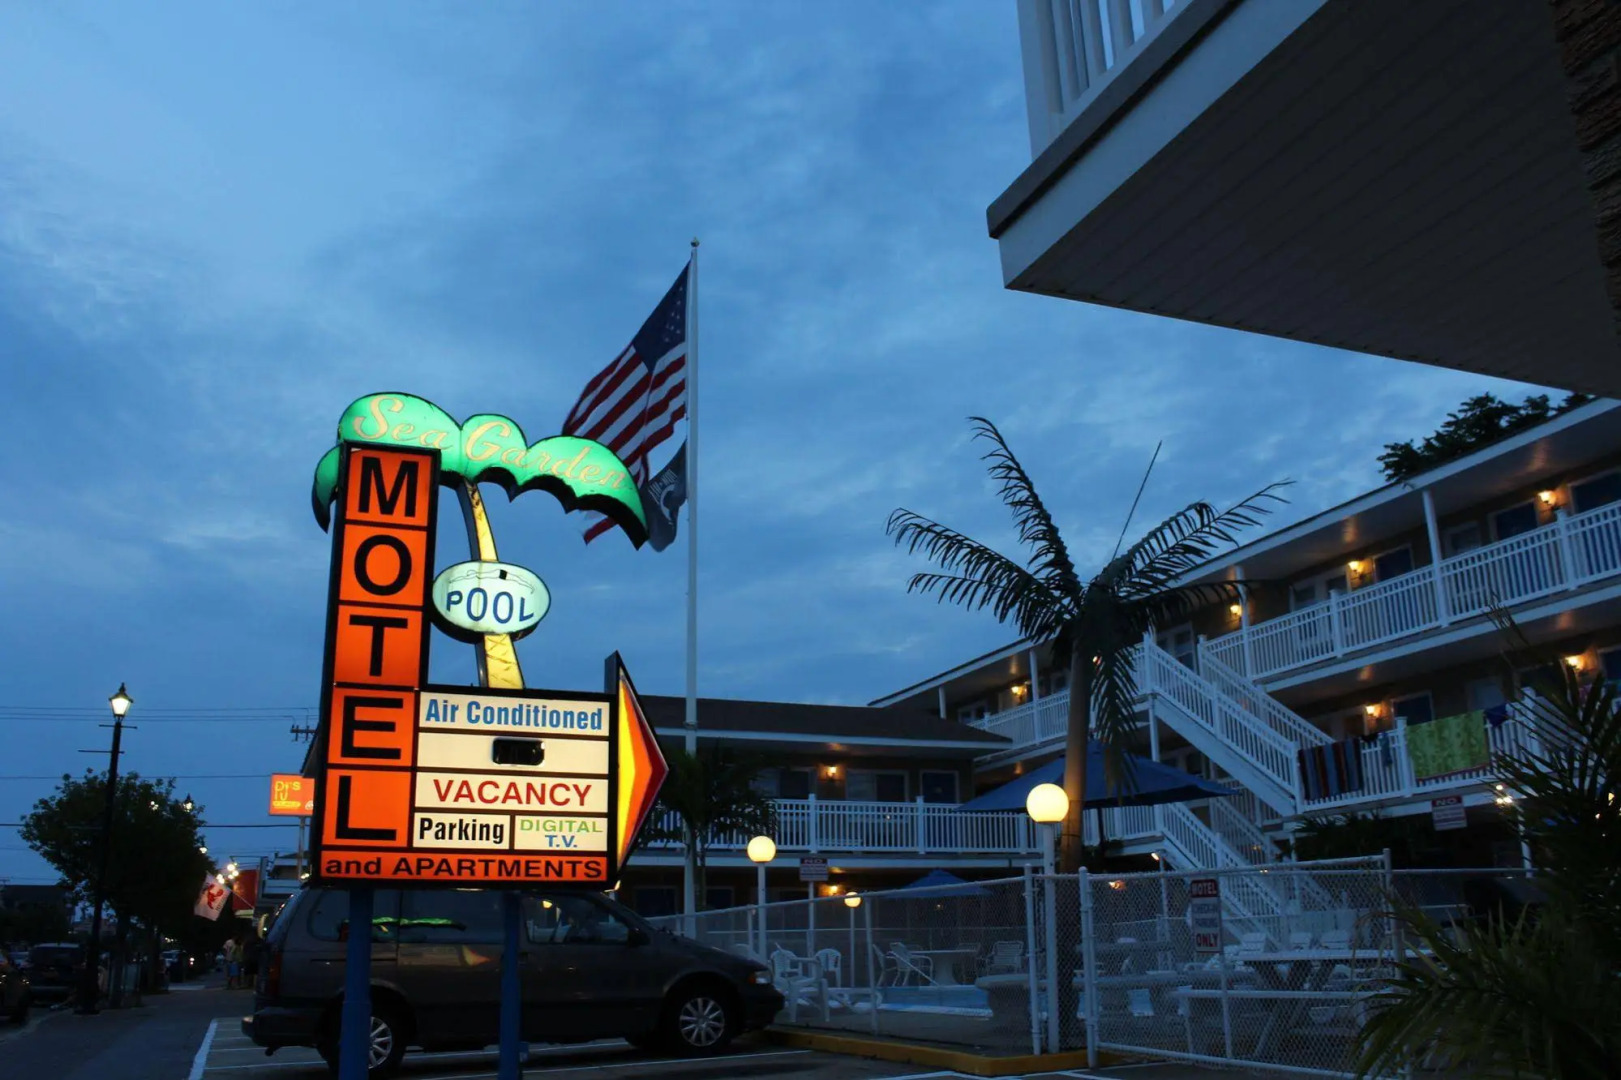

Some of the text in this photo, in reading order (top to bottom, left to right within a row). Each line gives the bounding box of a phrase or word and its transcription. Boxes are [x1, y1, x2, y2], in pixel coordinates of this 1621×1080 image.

[352, 394, 454, 451] Sea
[464, 420, 633, 490] Garden
[446, 587, 534, 624] POOL
[335, 456, 420, 841] MOTEL
[425, 698, 603, 731] Air Conditioned
[433, 779, 592, 806] VACANCY
[419, 817, 505, 844] Parking
[519, 818, 603, 834] DIGITAL
[544, 834, 578, 848] T.V.
[325, 856, 603, 878] and APARTMENTS
[1191, 882, 1218, 895] MOTEL
[1195, 933, 1218, 947] ONLY
